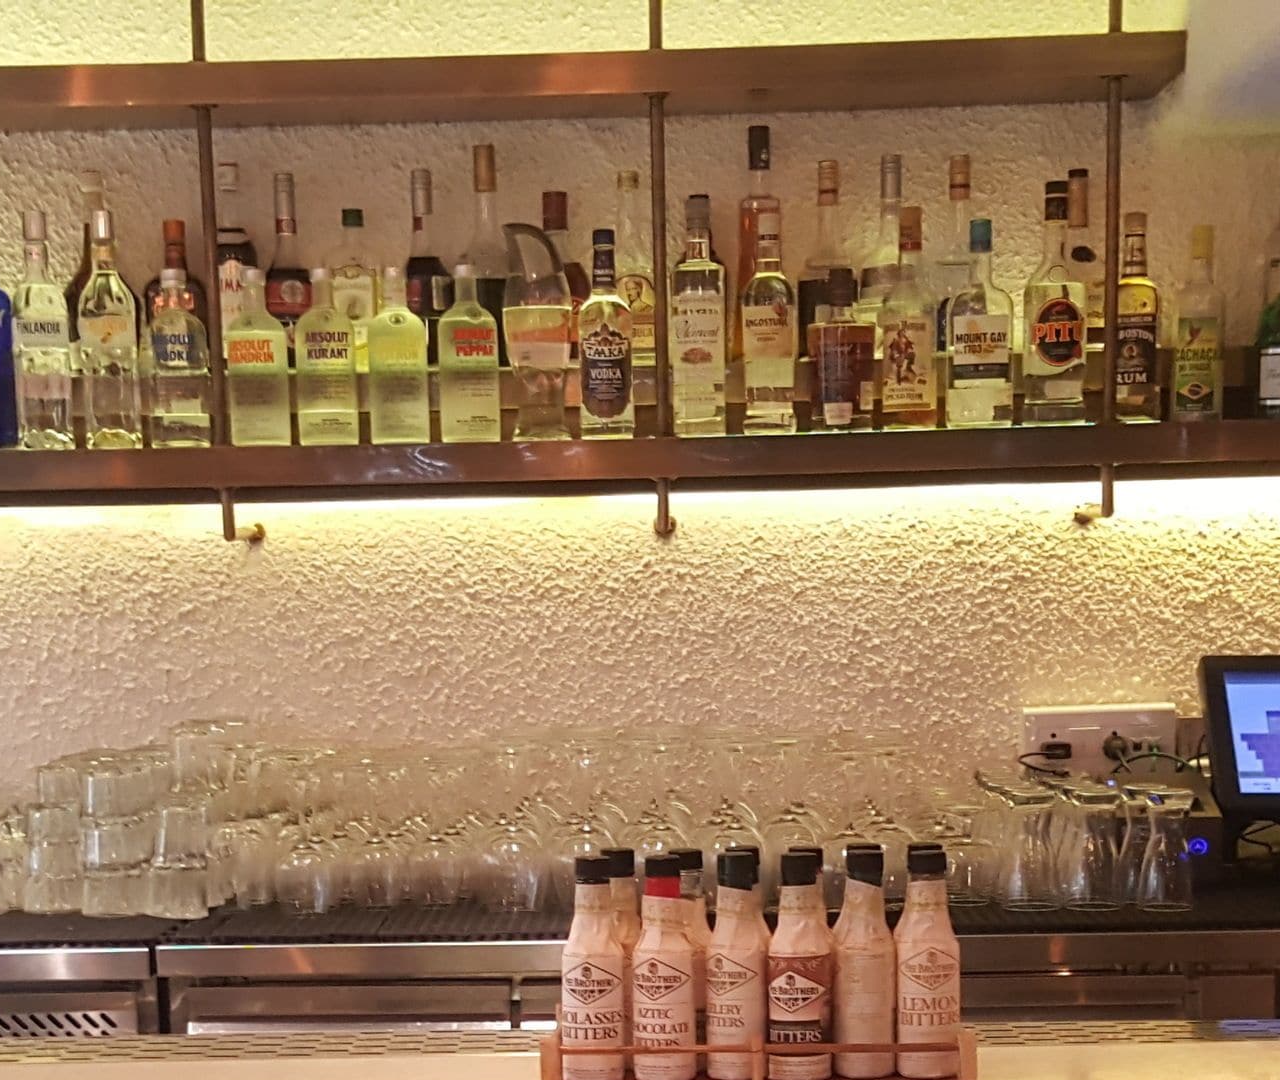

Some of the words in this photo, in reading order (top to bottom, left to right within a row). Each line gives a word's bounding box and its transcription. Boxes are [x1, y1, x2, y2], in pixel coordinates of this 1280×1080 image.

[305, 332, 349, 344] ABSOLUT
[955, 332, 989, 345] MOUNT
[990, 331, 1008, 344] GAY
[307, 348, 349, 360] KURANT
[590, 367, 623, 380] VODKA
[1116, 372, 1148, 384] RUM
